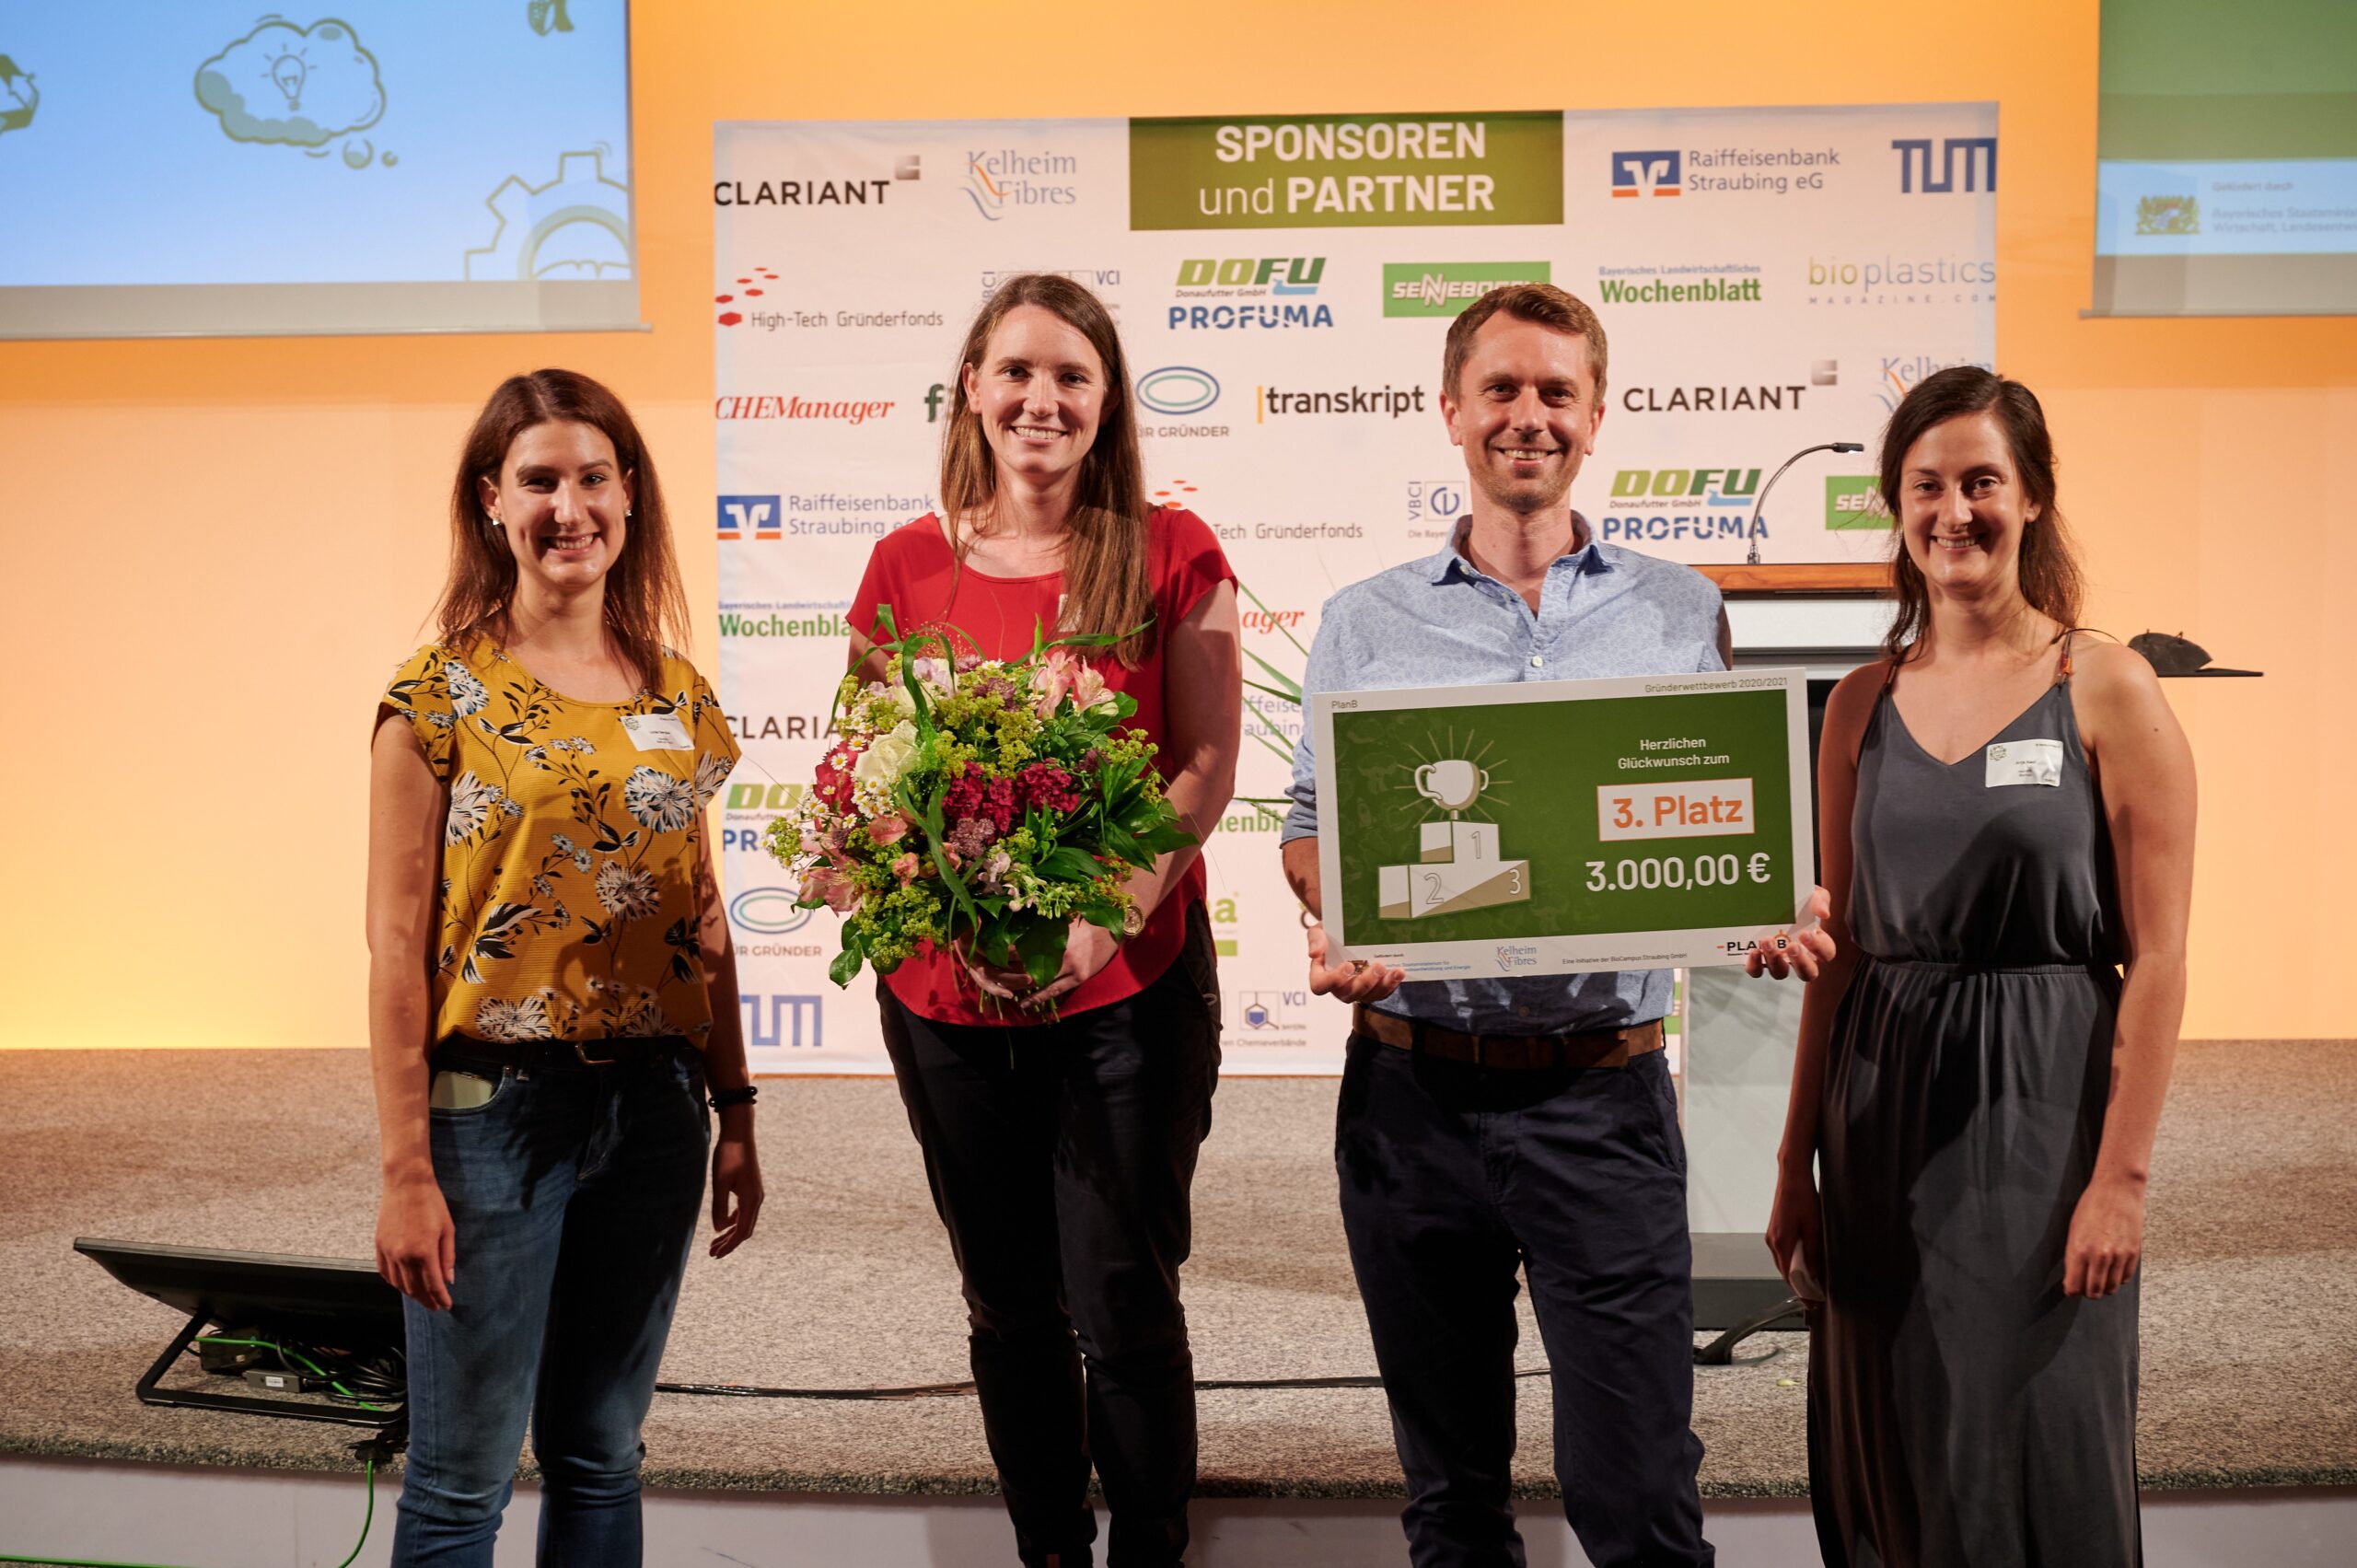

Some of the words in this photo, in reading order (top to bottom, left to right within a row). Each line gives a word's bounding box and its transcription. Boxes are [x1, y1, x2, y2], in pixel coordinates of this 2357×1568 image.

[1215, 122, 1485, 162] SPONSOREN
[968, 151, 1076, 175] Kelheim
[1689, 148, 1840, 168] Raiffeisenbank
[1891, 138, 1996, 193] TUM
[714, 180, 889, 205] CLARIANT
[1199, 179, 1274, 215] und
[1287, 174, 1495, 213] PARTNER
[1689, 173, 1788, 193] Straubing
[1795, 173, 1824, 189] eG
[997, 185, 1076, 205] Fibres
[1096, 270, 1120, 285] VCI
[1176, 258, 1326, 285] DOFU
[1809, 255, 1996, 293] bioplastics
[1237, 287, 1267, 297] GmbH
[1599, 278, 1761, 303] Wochenblatt
[751, 311, 828, 331] High-Tech
[837, 310, 944, 329] Gründerfonds
[1169, 304, 1333, 330] PROFUMA
[714, 396, 895, 424] CHEManager
[1267, 386, 1424, 419] transkript
[1623, 386, 1805, 412] CLARIANT
[1157, 424, 1230, 437] GRÜNDER
[1609, 469, 1761, 496] DOFU
[789, 495, 935, 511] Raiffeisenbank
[1408, 481, 1422, 521] VBCI
[1672, 498, 1701, 507] GmbH
[789, 518, 885, 539] Straubing
[1255, 523, 1364, 539] Gründerfonds
[1603, 517, 1769, 540] PROFUMA
[1644, 680, 1737, 693] Gründerwettbewerb
[1739, 677, 1788, 689] 2020/2021
[1331, 700, 1358, 709] PlanB
[1640, 737, 1706, 750] Herzlichen
[1618, 754, 1701, 770] Glückwunsch
[1703, 754, 1730, 765] zum
[1612, 798, 1643, 829] 3.
[1655, 795, 1743, 827] Platz
[1471, 831, 1481, 859] 1
[1509, 869, 1521, 895] 3
[1585, 854, 1739, 892] 3.000,00
[1747, 852, 1771, 884] €
[1424, 873, 1445, 905] 2
[752, 943, 822, 957] GRÜNDER
[1497, 946, 1537, 956] Kelheim
[1507, 957, 1538, 966] Fibres
[1283, 992, 1306, 1005] VCI
